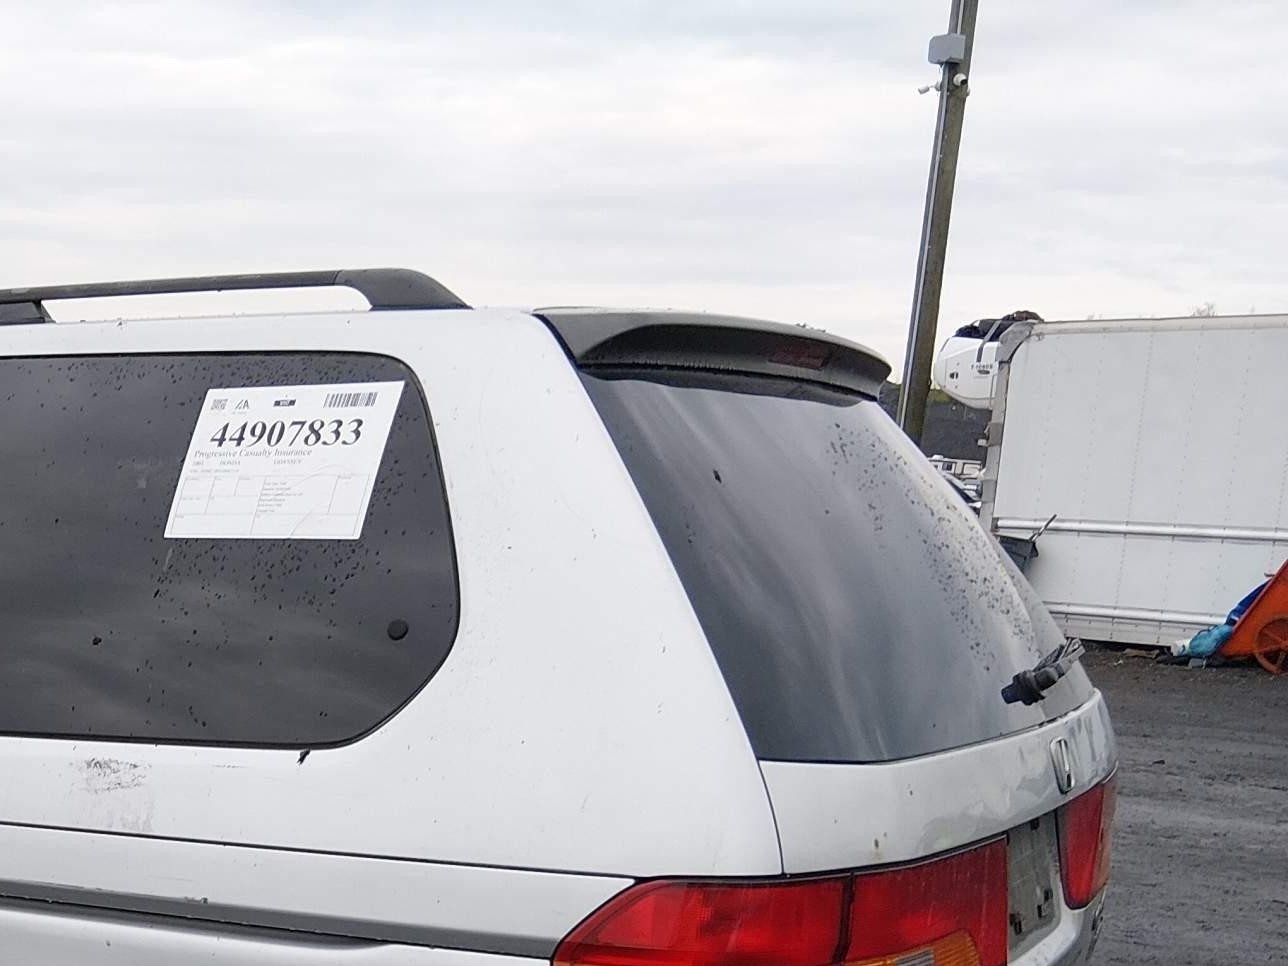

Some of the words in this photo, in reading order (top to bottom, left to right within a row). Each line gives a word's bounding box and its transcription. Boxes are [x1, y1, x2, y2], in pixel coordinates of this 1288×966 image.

[210, 418, 364, 448] 44907833
[193, 449, 238, 459] Progressive
[239, 448, 273, 459] Casualty
[273, 447, 313, 457] Insurance
